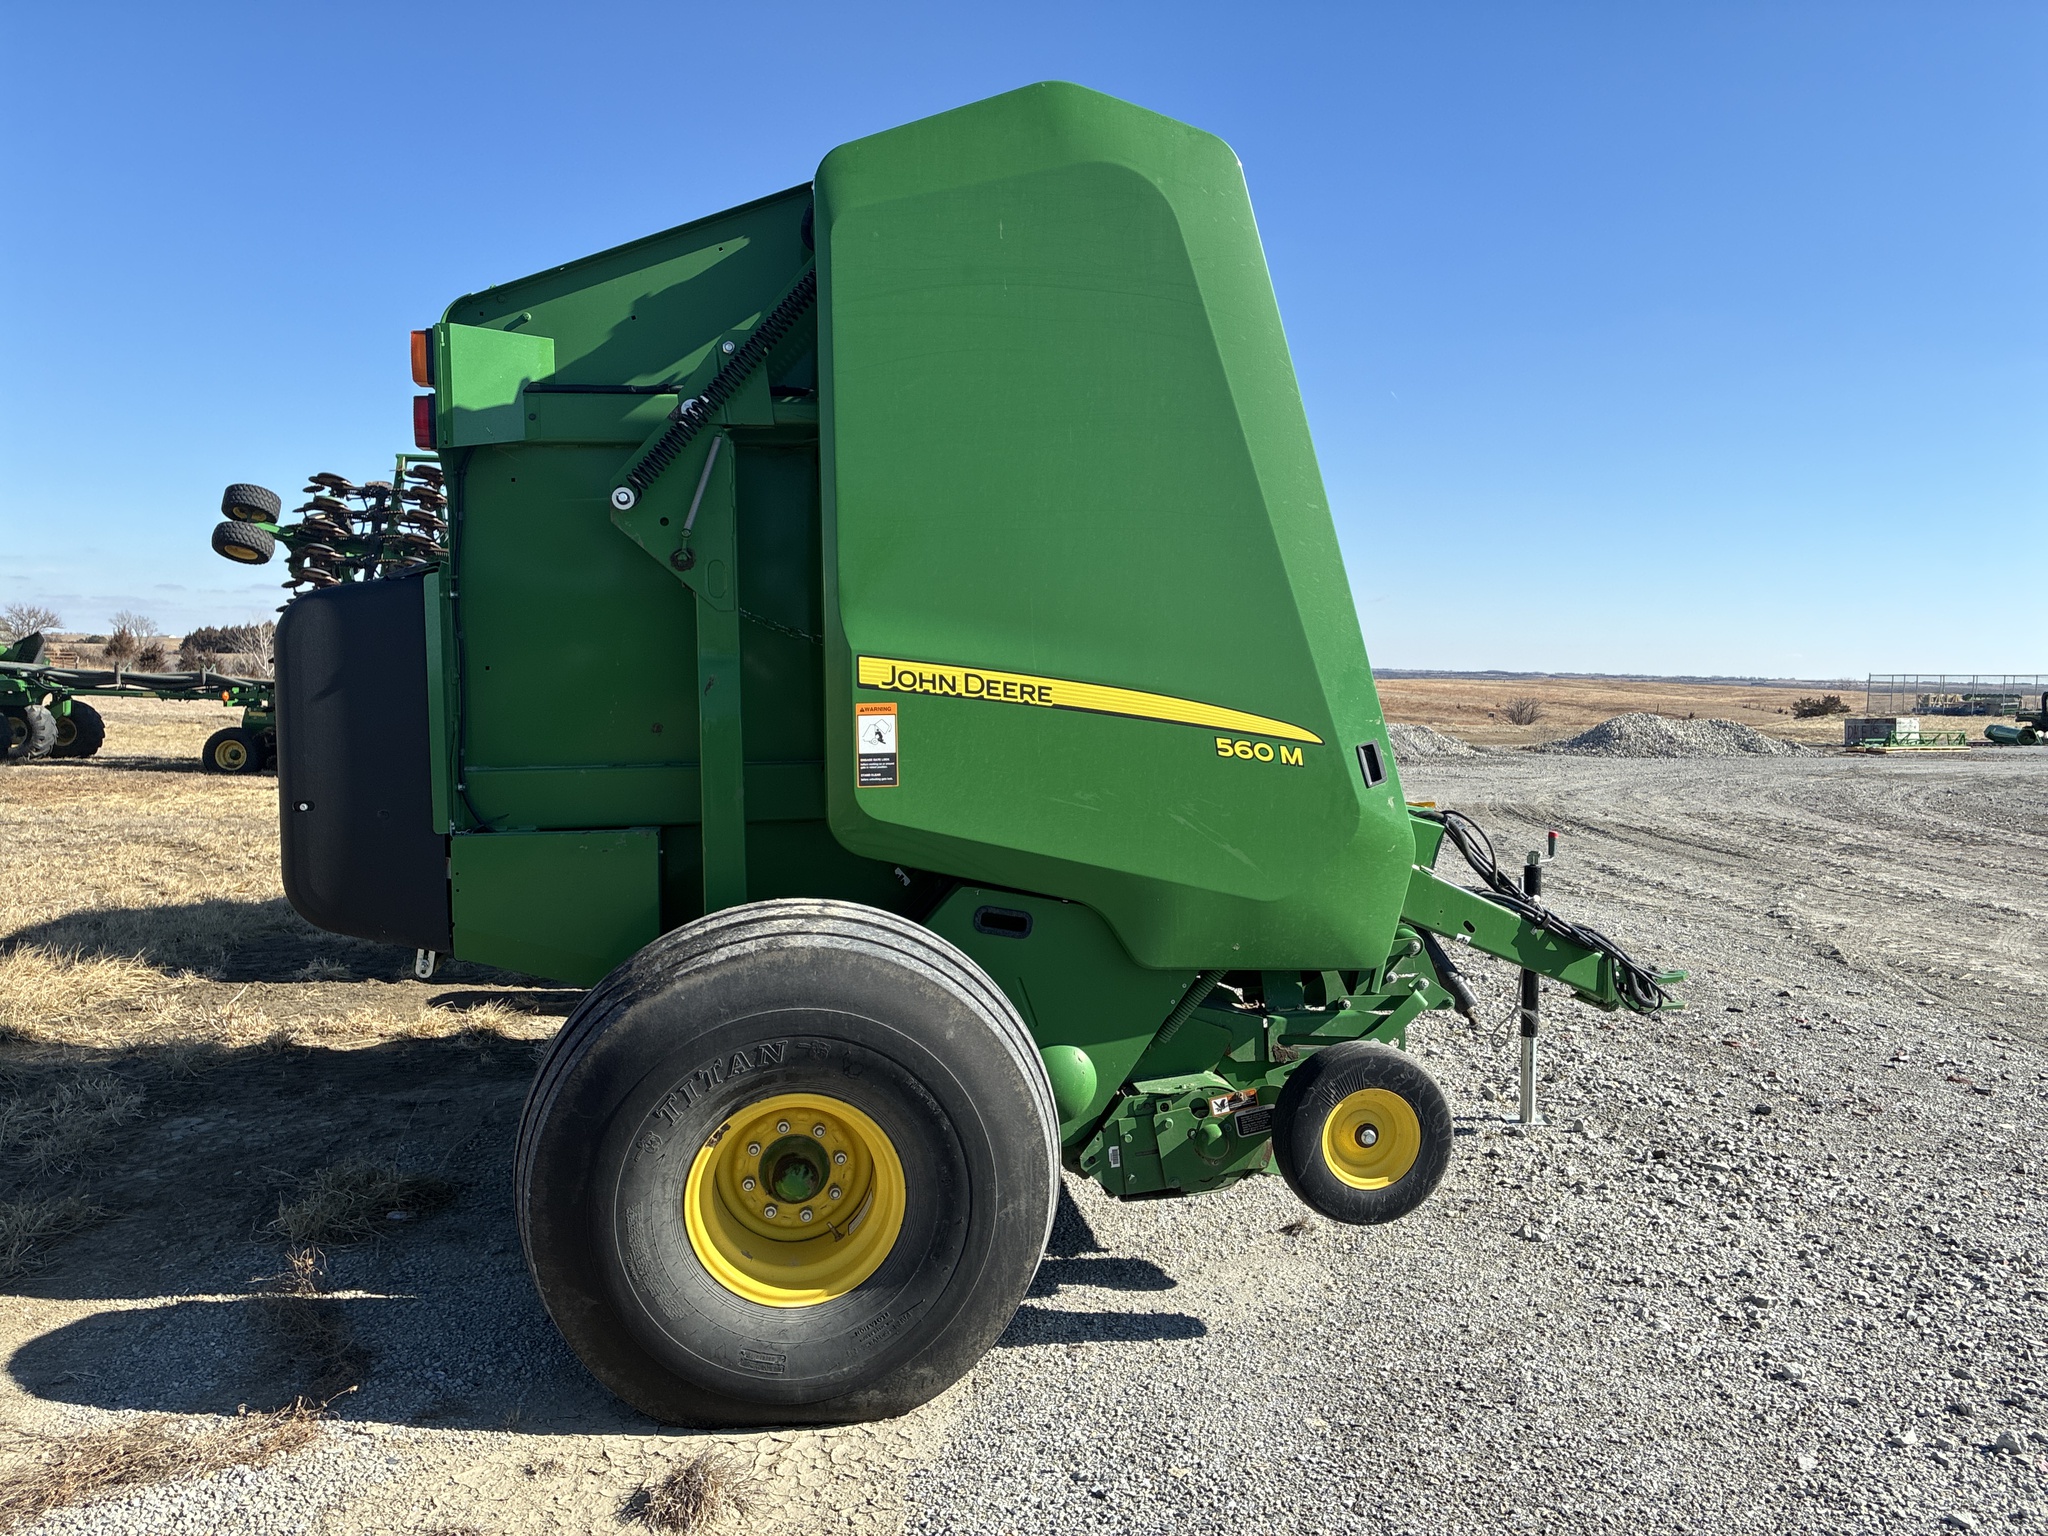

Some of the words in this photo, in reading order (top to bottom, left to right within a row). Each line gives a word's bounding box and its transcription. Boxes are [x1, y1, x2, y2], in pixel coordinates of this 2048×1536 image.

[881, 665, 957, 693] JOHN
[964, 673, 1053, 703] DEERE
[1214, 736, 1275, 763] 560
[1279, 744, 1304, 768] M
[652, 1040, 789, 1127] TITAN
